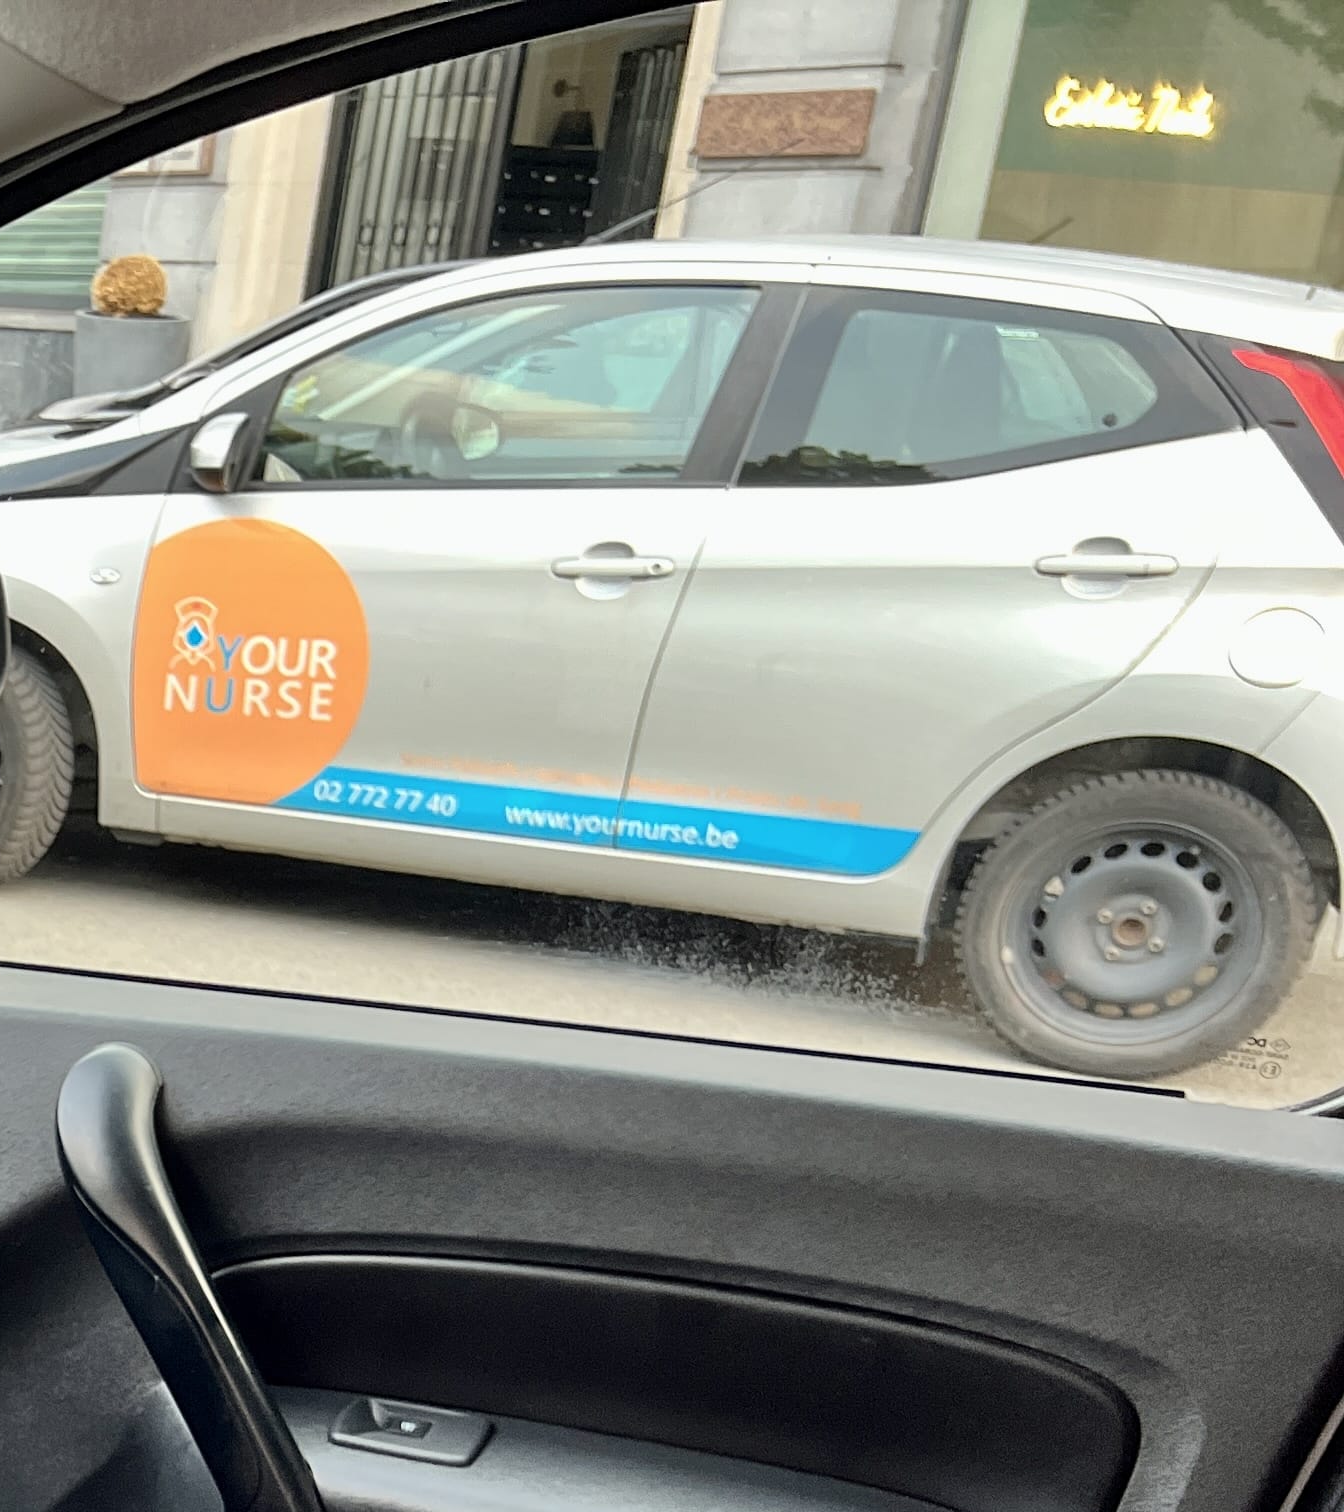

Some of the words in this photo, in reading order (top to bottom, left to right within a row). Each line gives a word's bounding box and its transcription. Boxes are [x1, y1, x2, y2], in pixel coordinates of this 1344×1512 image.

[217, 634, 337, 680] YOUR
[164, 673, 334, 722] NURSE
[313, 780, 342, 803] 02
[348, 783, 389, 809] 772
[394, 787, 424, 813] 77
[426, 792, 458, 817] 40
[505, 805, 740, 849] www.yournurse.be
